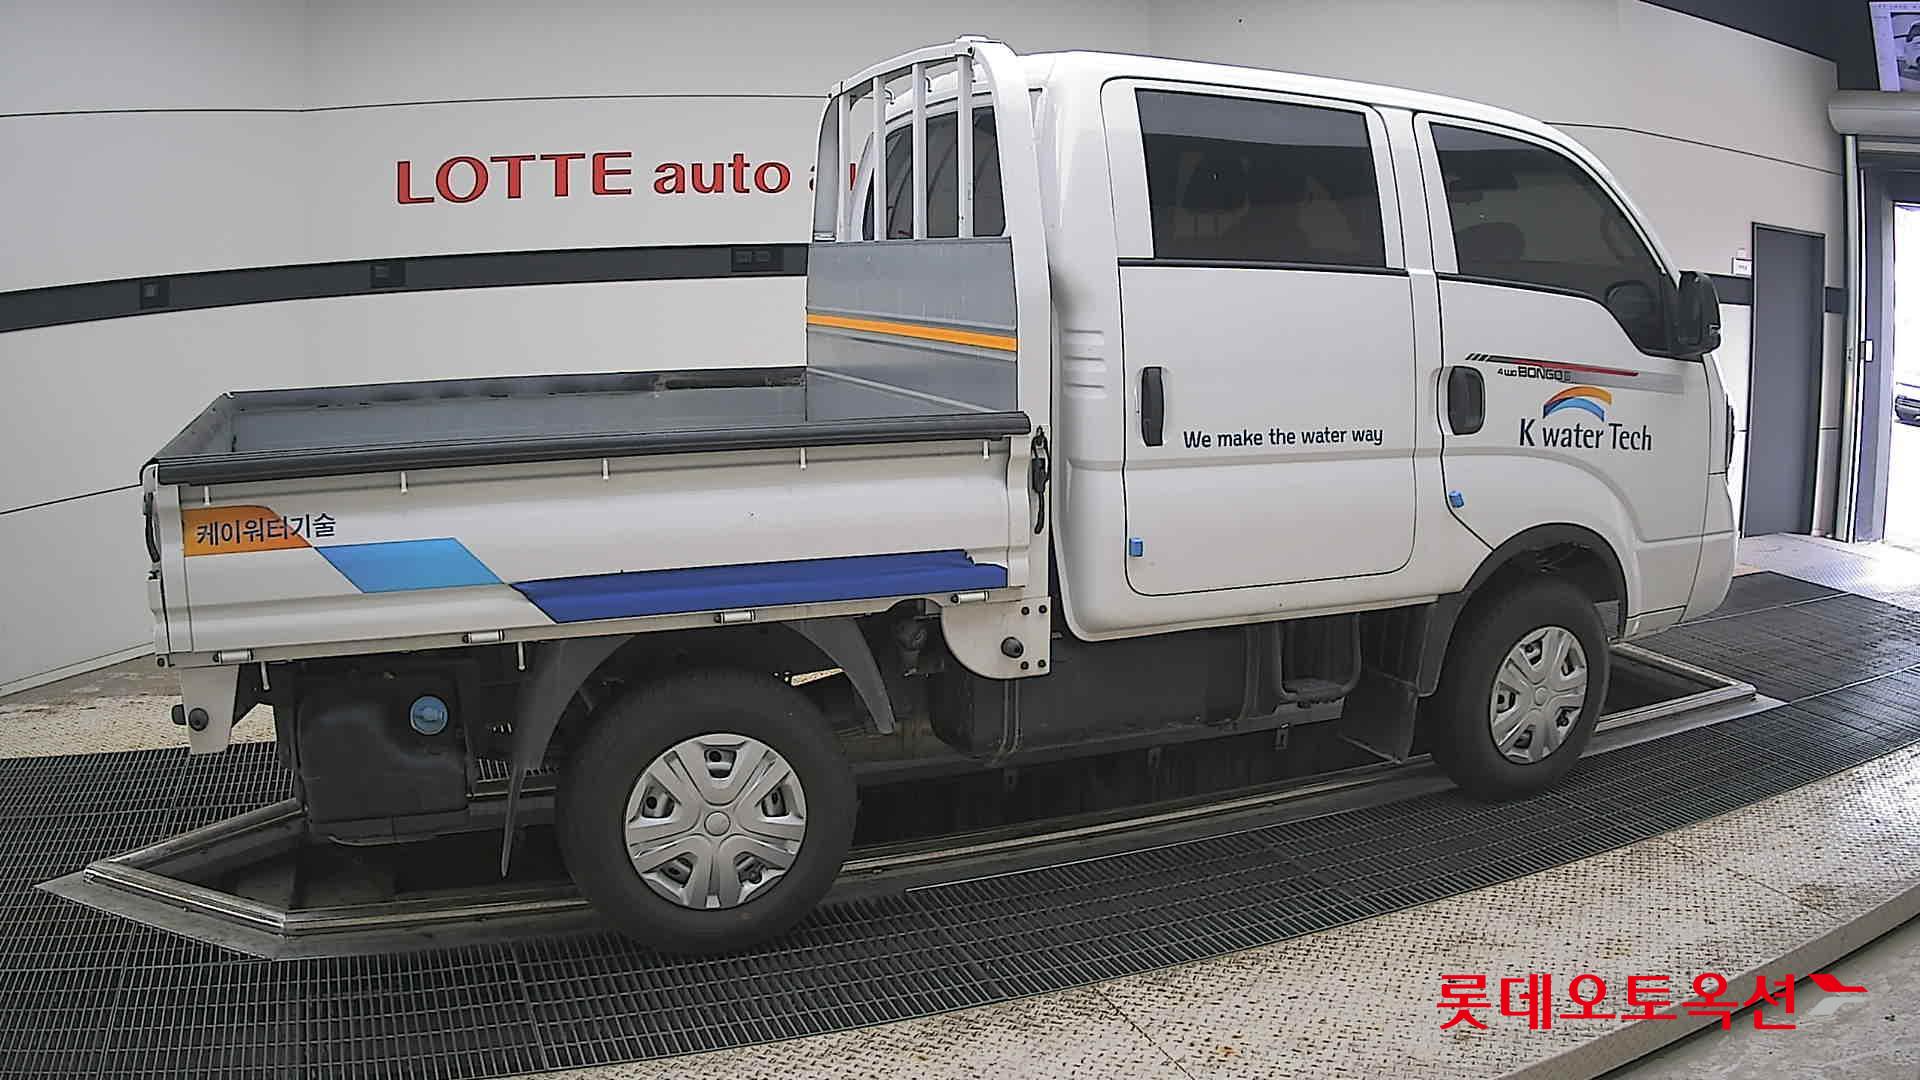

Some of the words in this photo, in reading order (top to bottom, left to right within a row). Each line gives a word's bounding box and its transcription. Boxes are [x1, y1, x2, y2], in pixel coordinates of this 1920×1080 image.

[397, 151, 632, 204] LOTTE
[653, 152, 791, 194] auto
[1183, 430, 1212, 448] We
[1217, 428, 1263, 447] make
[1268, 427, 1296, 445] the
[1301, 426, 1348, 444] water
[1352, 428, 1384, 446] way
[1519, 418, 1536, 447] K
[1542, 422, 1604, 449] water
[1608, 423, 1652, 451] Tech
[196, 512, 337, 546] 케이워터기술
